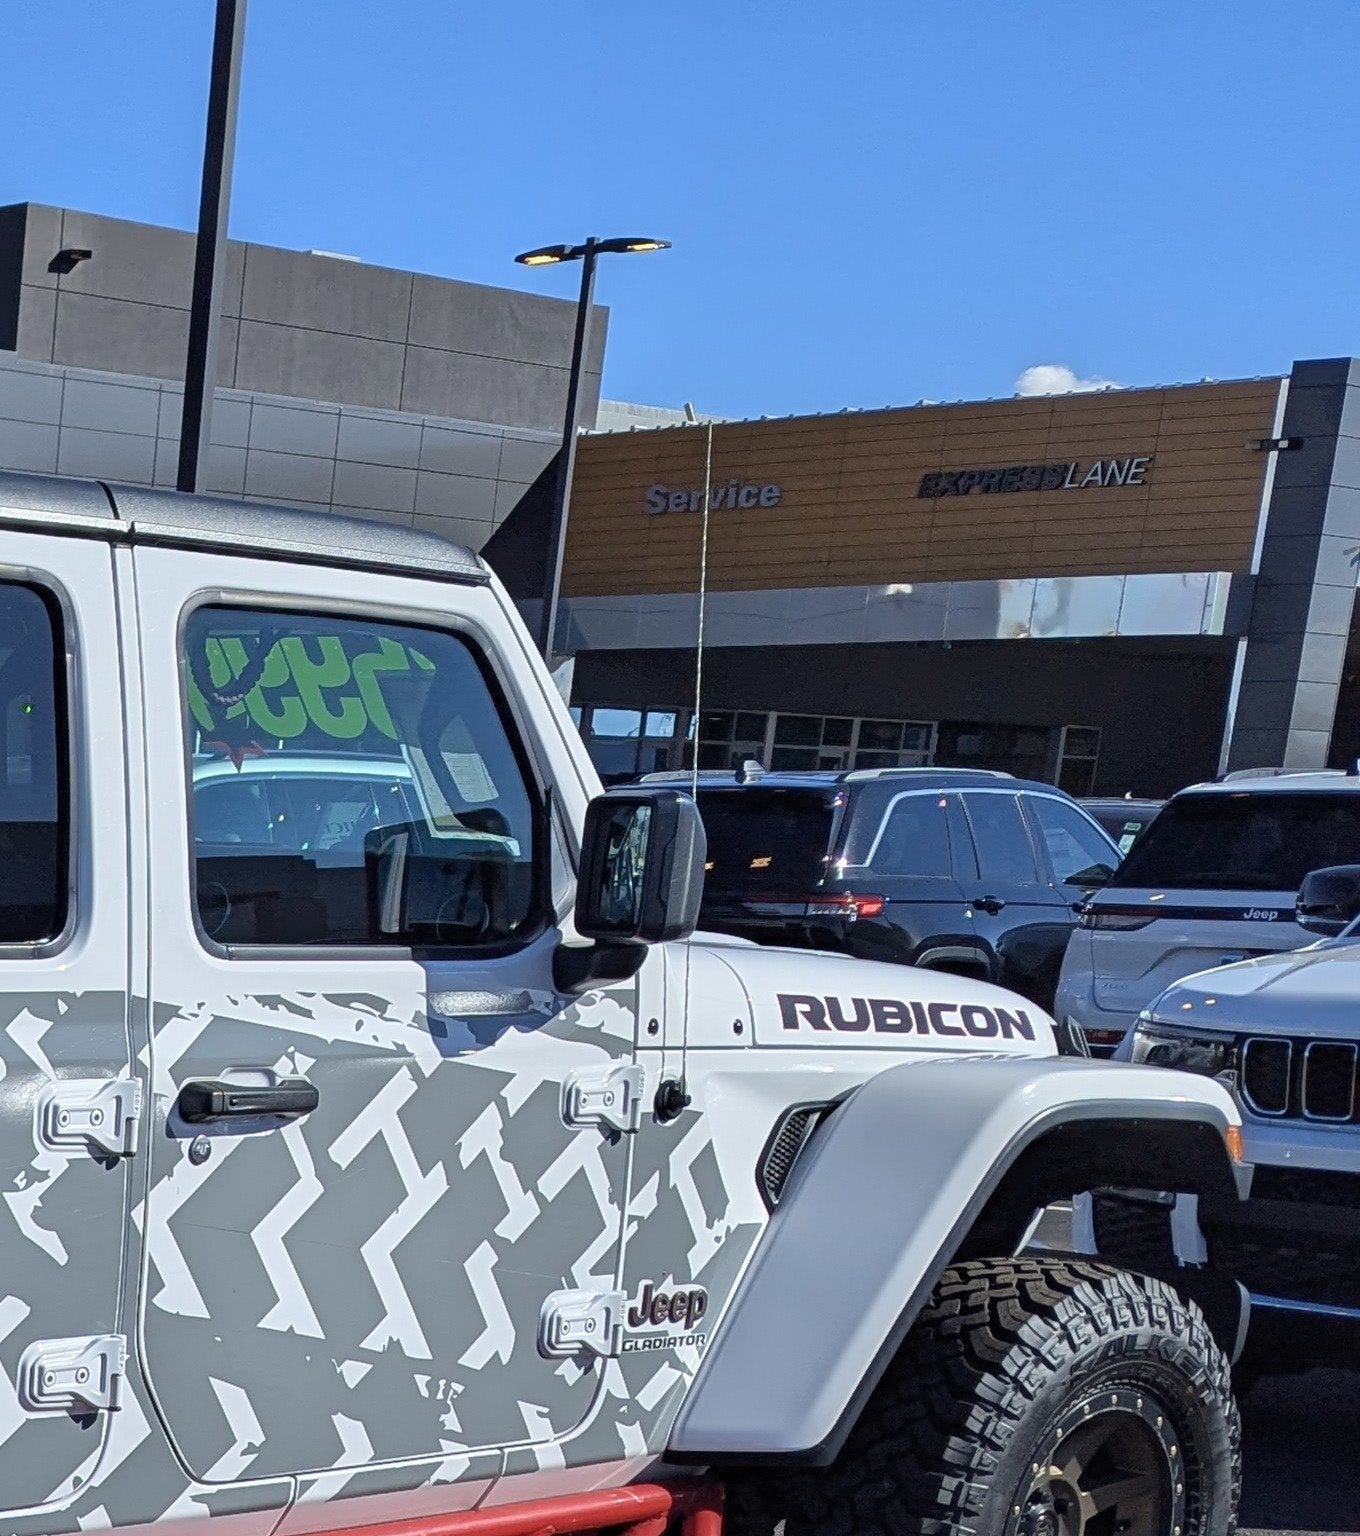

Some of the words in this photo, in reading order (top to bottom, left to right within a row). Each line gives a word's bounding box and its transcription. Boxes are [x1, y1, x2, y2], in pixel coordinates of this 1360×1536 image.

[644, 478, 781, 515] Service
[1243, 907, 1279, 921] Jeep
[777, 993, 1036, 1042] RUBICON
[627, 1283, 708, 1331] Jeep
[622, 1333, 707, 1353] GLADIATOR
